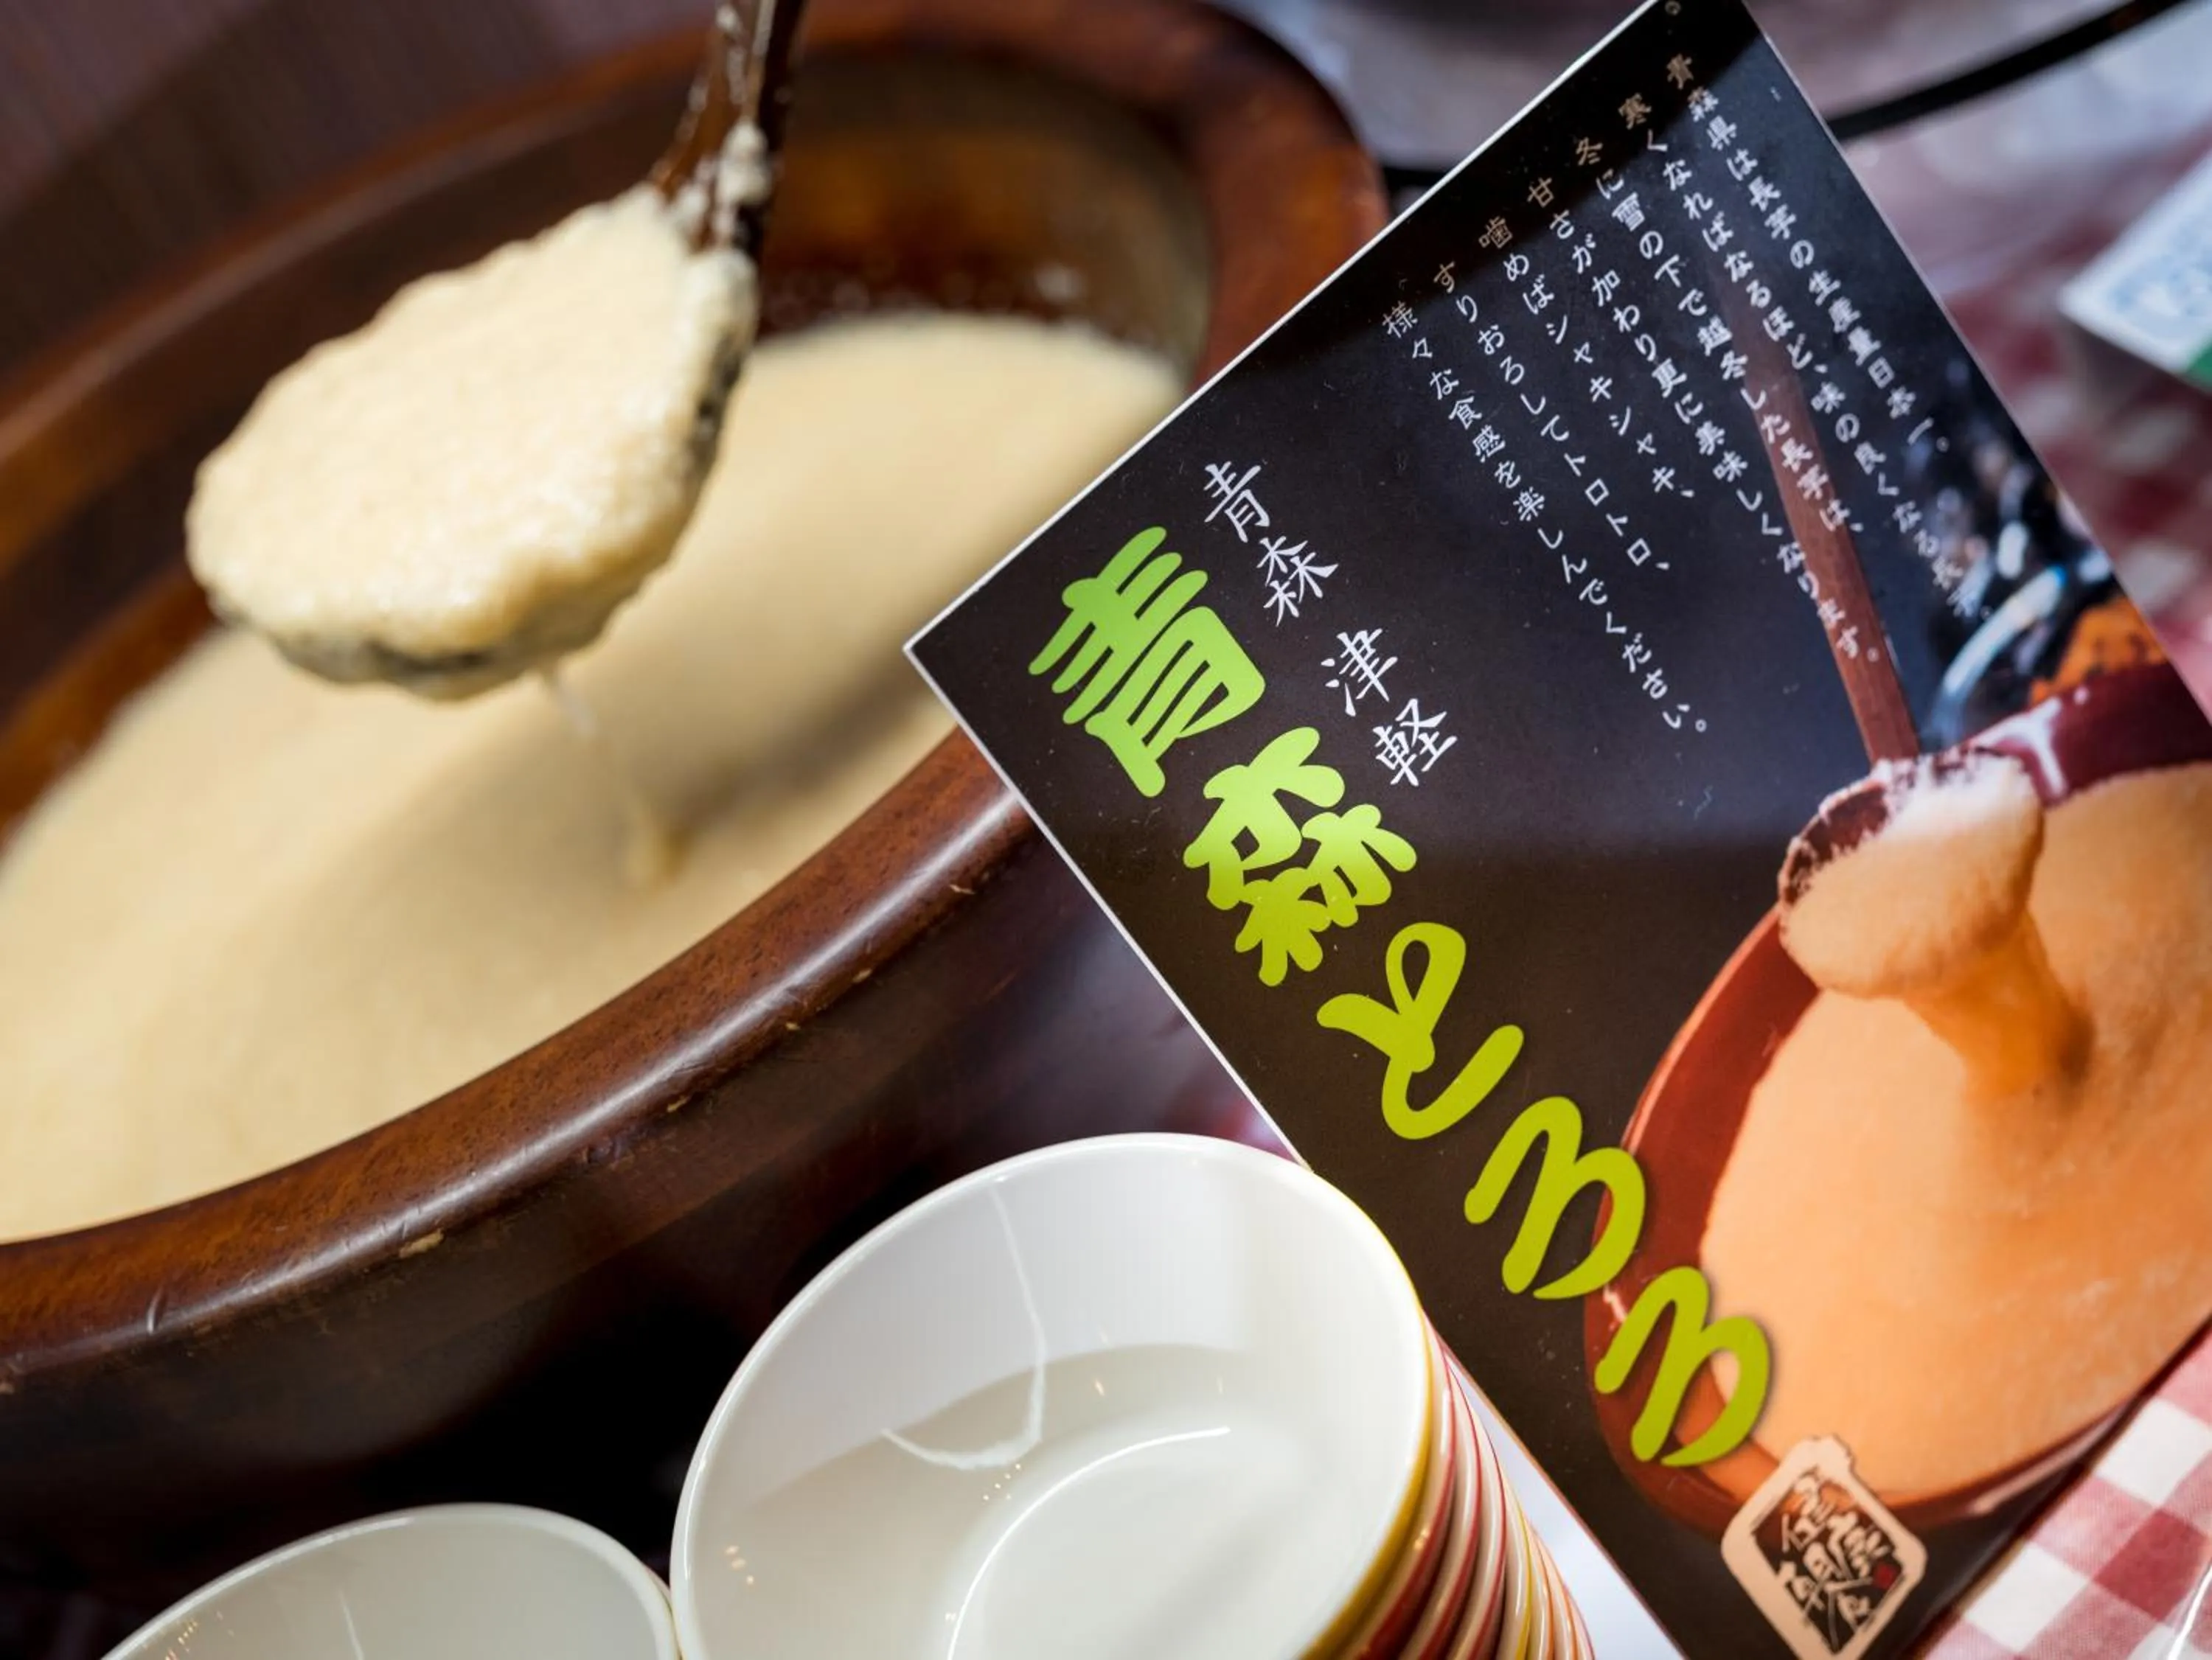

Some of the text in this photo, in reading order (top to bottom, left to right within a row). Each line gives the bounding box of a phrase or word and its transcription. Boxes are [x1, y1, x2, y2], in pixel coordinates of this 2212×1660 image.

[1382, 301, 1708, 733] 様々な食感を楽しんでください。
[1433, 261, 1671, 571] すりおろしてトロトロ、
[1478, 215, 1695, 499] 噛めばシャキシャキ、
[1527, 176, 1879, 662] 甘さが加わり更に美味しくなります。
[1575, 136, 1864, 533] 冬に雪の下で越冬した長芋は、
[1203, 460, 1458, 787] 青森 津軽
[1028, 526, 1770, 1467] 青森とろろ
